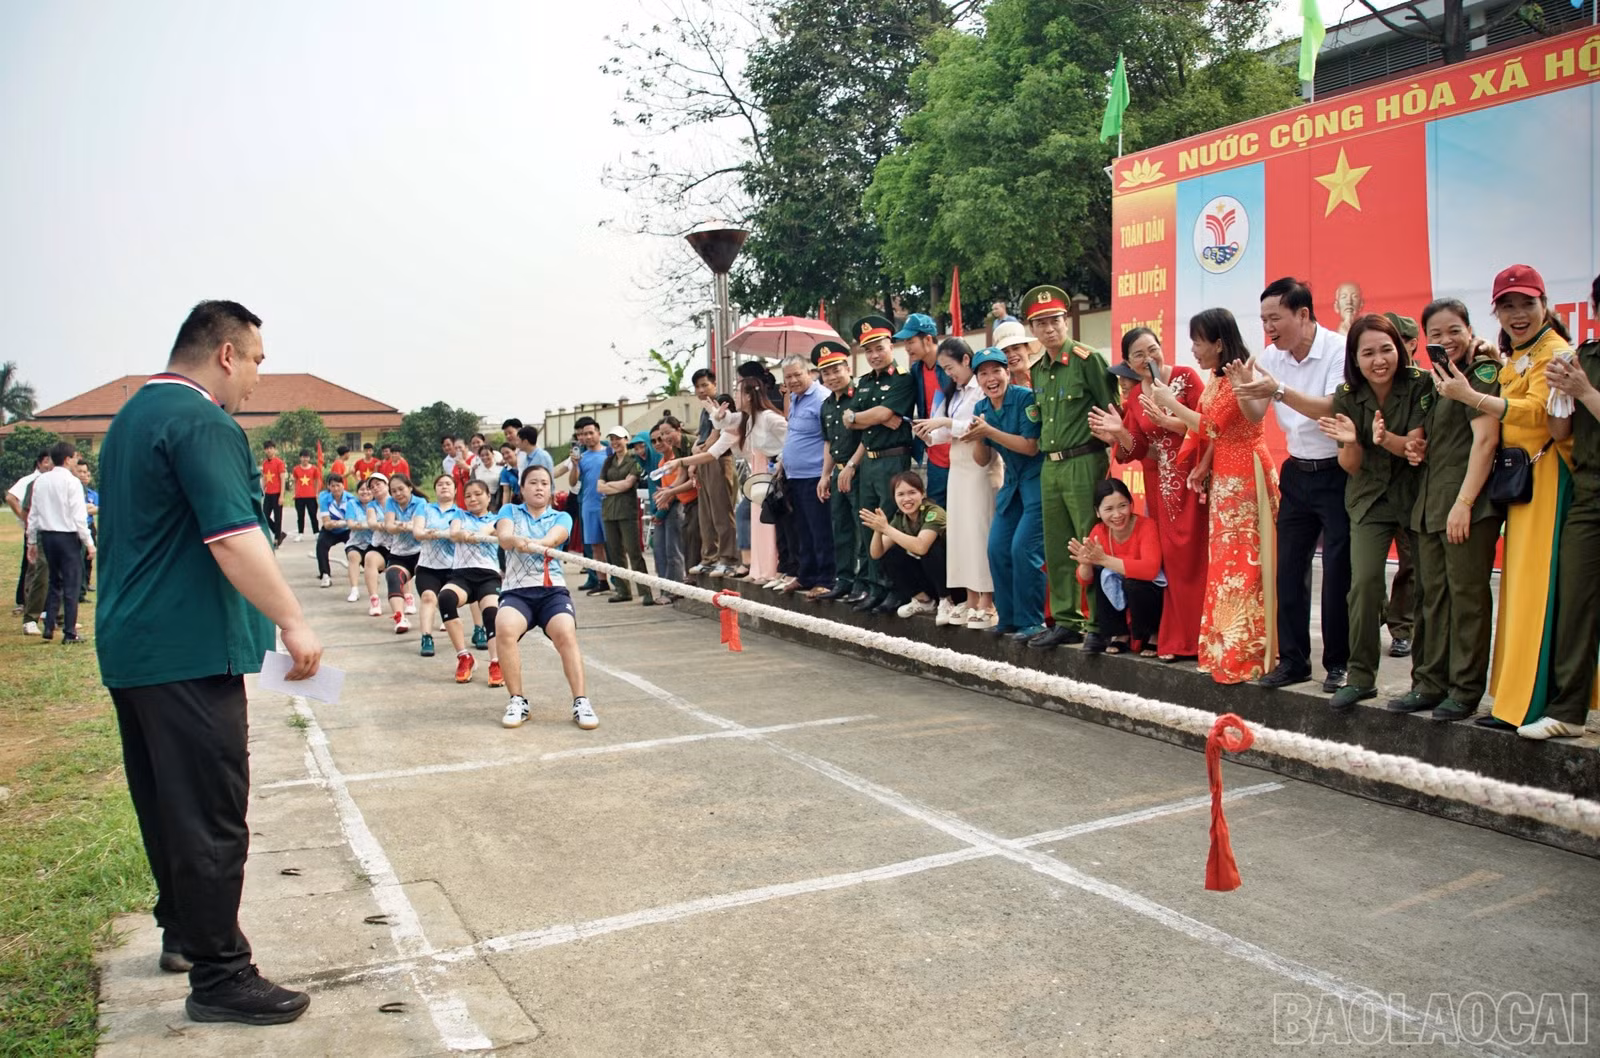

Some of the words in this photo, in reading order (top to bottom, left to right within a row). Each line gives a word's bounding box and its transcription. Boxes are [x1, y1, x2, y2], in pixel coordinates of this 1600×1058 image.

[1178, 132, 1259, 173] NƯỚC
[1270, 104, 1364, 148] CỘNG
[1376, 82, 1457, 123] HÒA
[1469, 56, 1530, 101] XÃ
